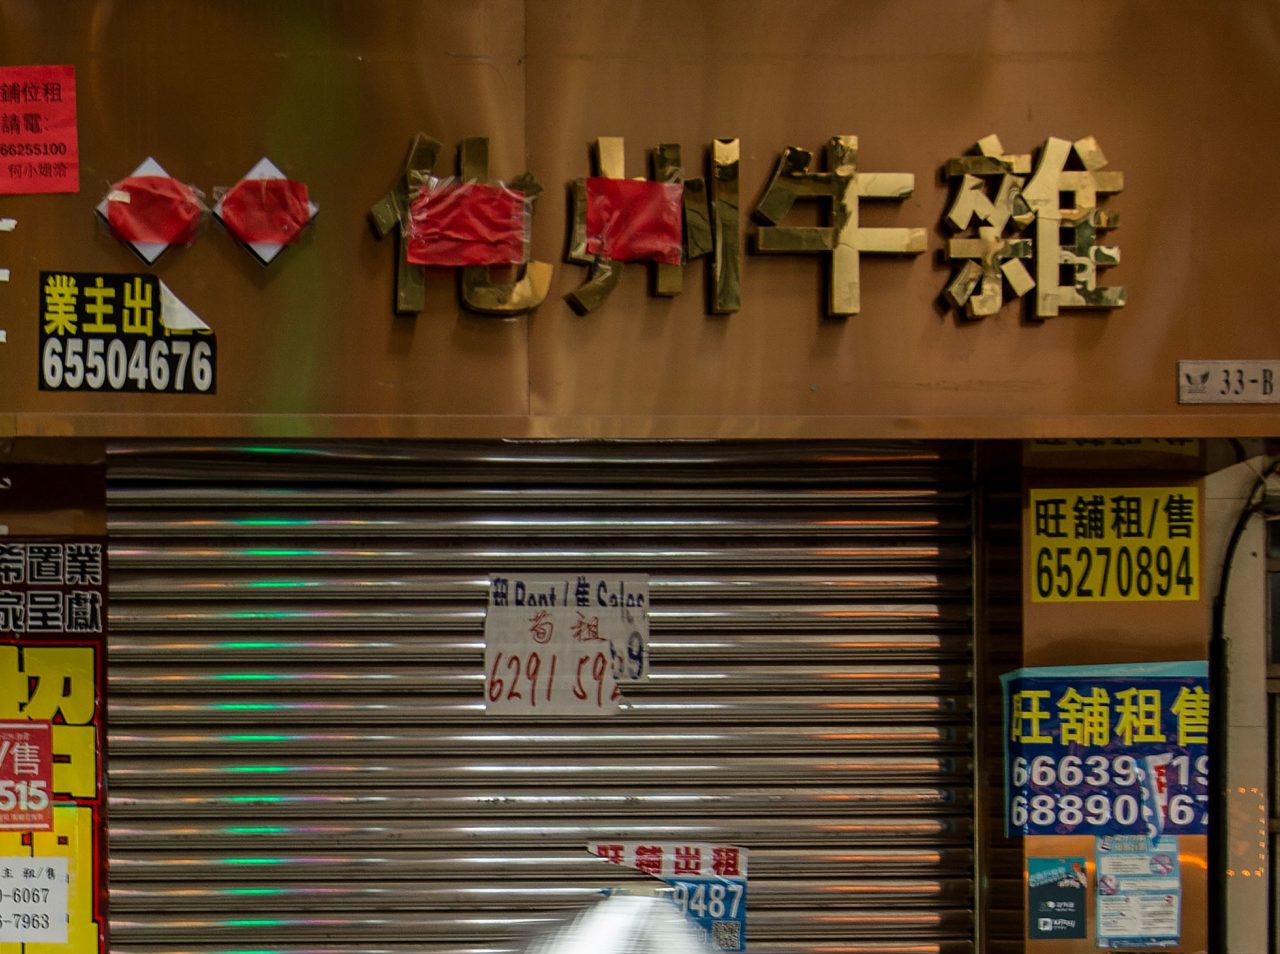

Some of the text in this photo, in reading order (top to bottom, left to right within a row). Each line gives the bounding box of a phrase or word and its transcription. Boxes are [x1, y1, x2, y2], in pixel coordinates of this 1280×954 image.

[0, 143, 67, 156] 66255100
[44, 274, 186, 337] 業主出
[43, 338, 212, 391] 65504676
[1219, 368, 1274, 395] 33-B
[1036, 546, 1194, 598] 65270894
[1012, 755, 1209, 787] 6663919
[672, 881, 743, 919] 9487
